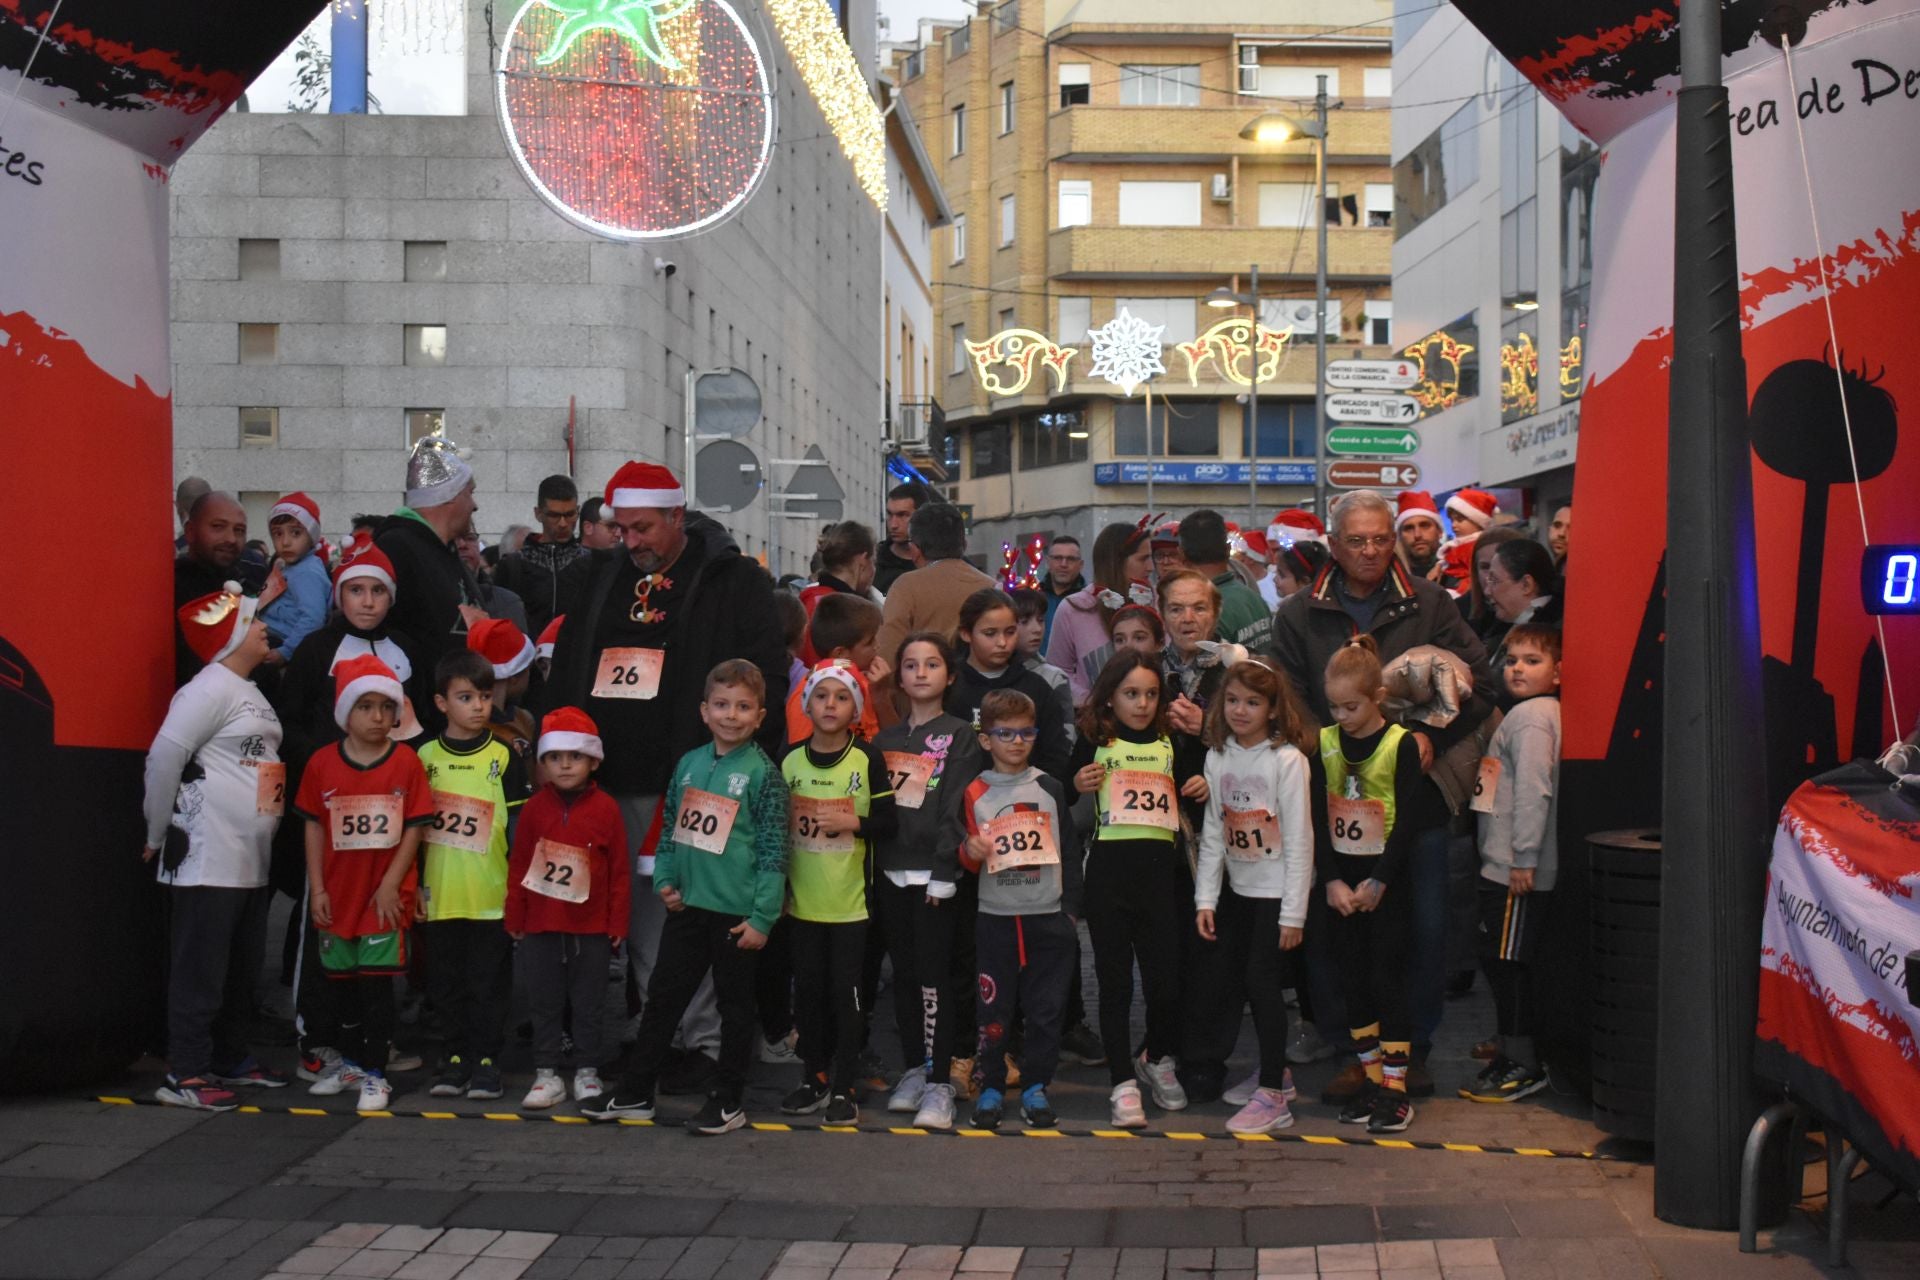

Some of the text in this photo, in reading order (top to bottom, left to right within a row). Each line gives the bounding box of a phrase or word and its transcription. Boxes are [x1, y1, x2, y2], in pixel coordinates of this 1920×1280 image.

[1729, 58, 1920, 136] ea de De
[1331, 399, 1368, 407] MERCADO
[1340, 408, 1371, 416] ABASTOS
[1329, 436, 1361, 444] Avenida
[1330, 470, 1380, 479] Ayuntamiento
[1883, 554, 1917, 604] 0
[611, 665, 639, 686] 26
[1123, 789, 1170, 814] 234
[342, 814, 389, 836] 582
[431, 811, 478, 837] 625
[680, 807, 719, 836] 620
[798, 816, 841, 838] 37
[1334, 817, 1363, 841] 86
[994, 830, 1044, 856] 382
[543, 861, 573, 886] 22
[1869, 941, 1899, 980] de
